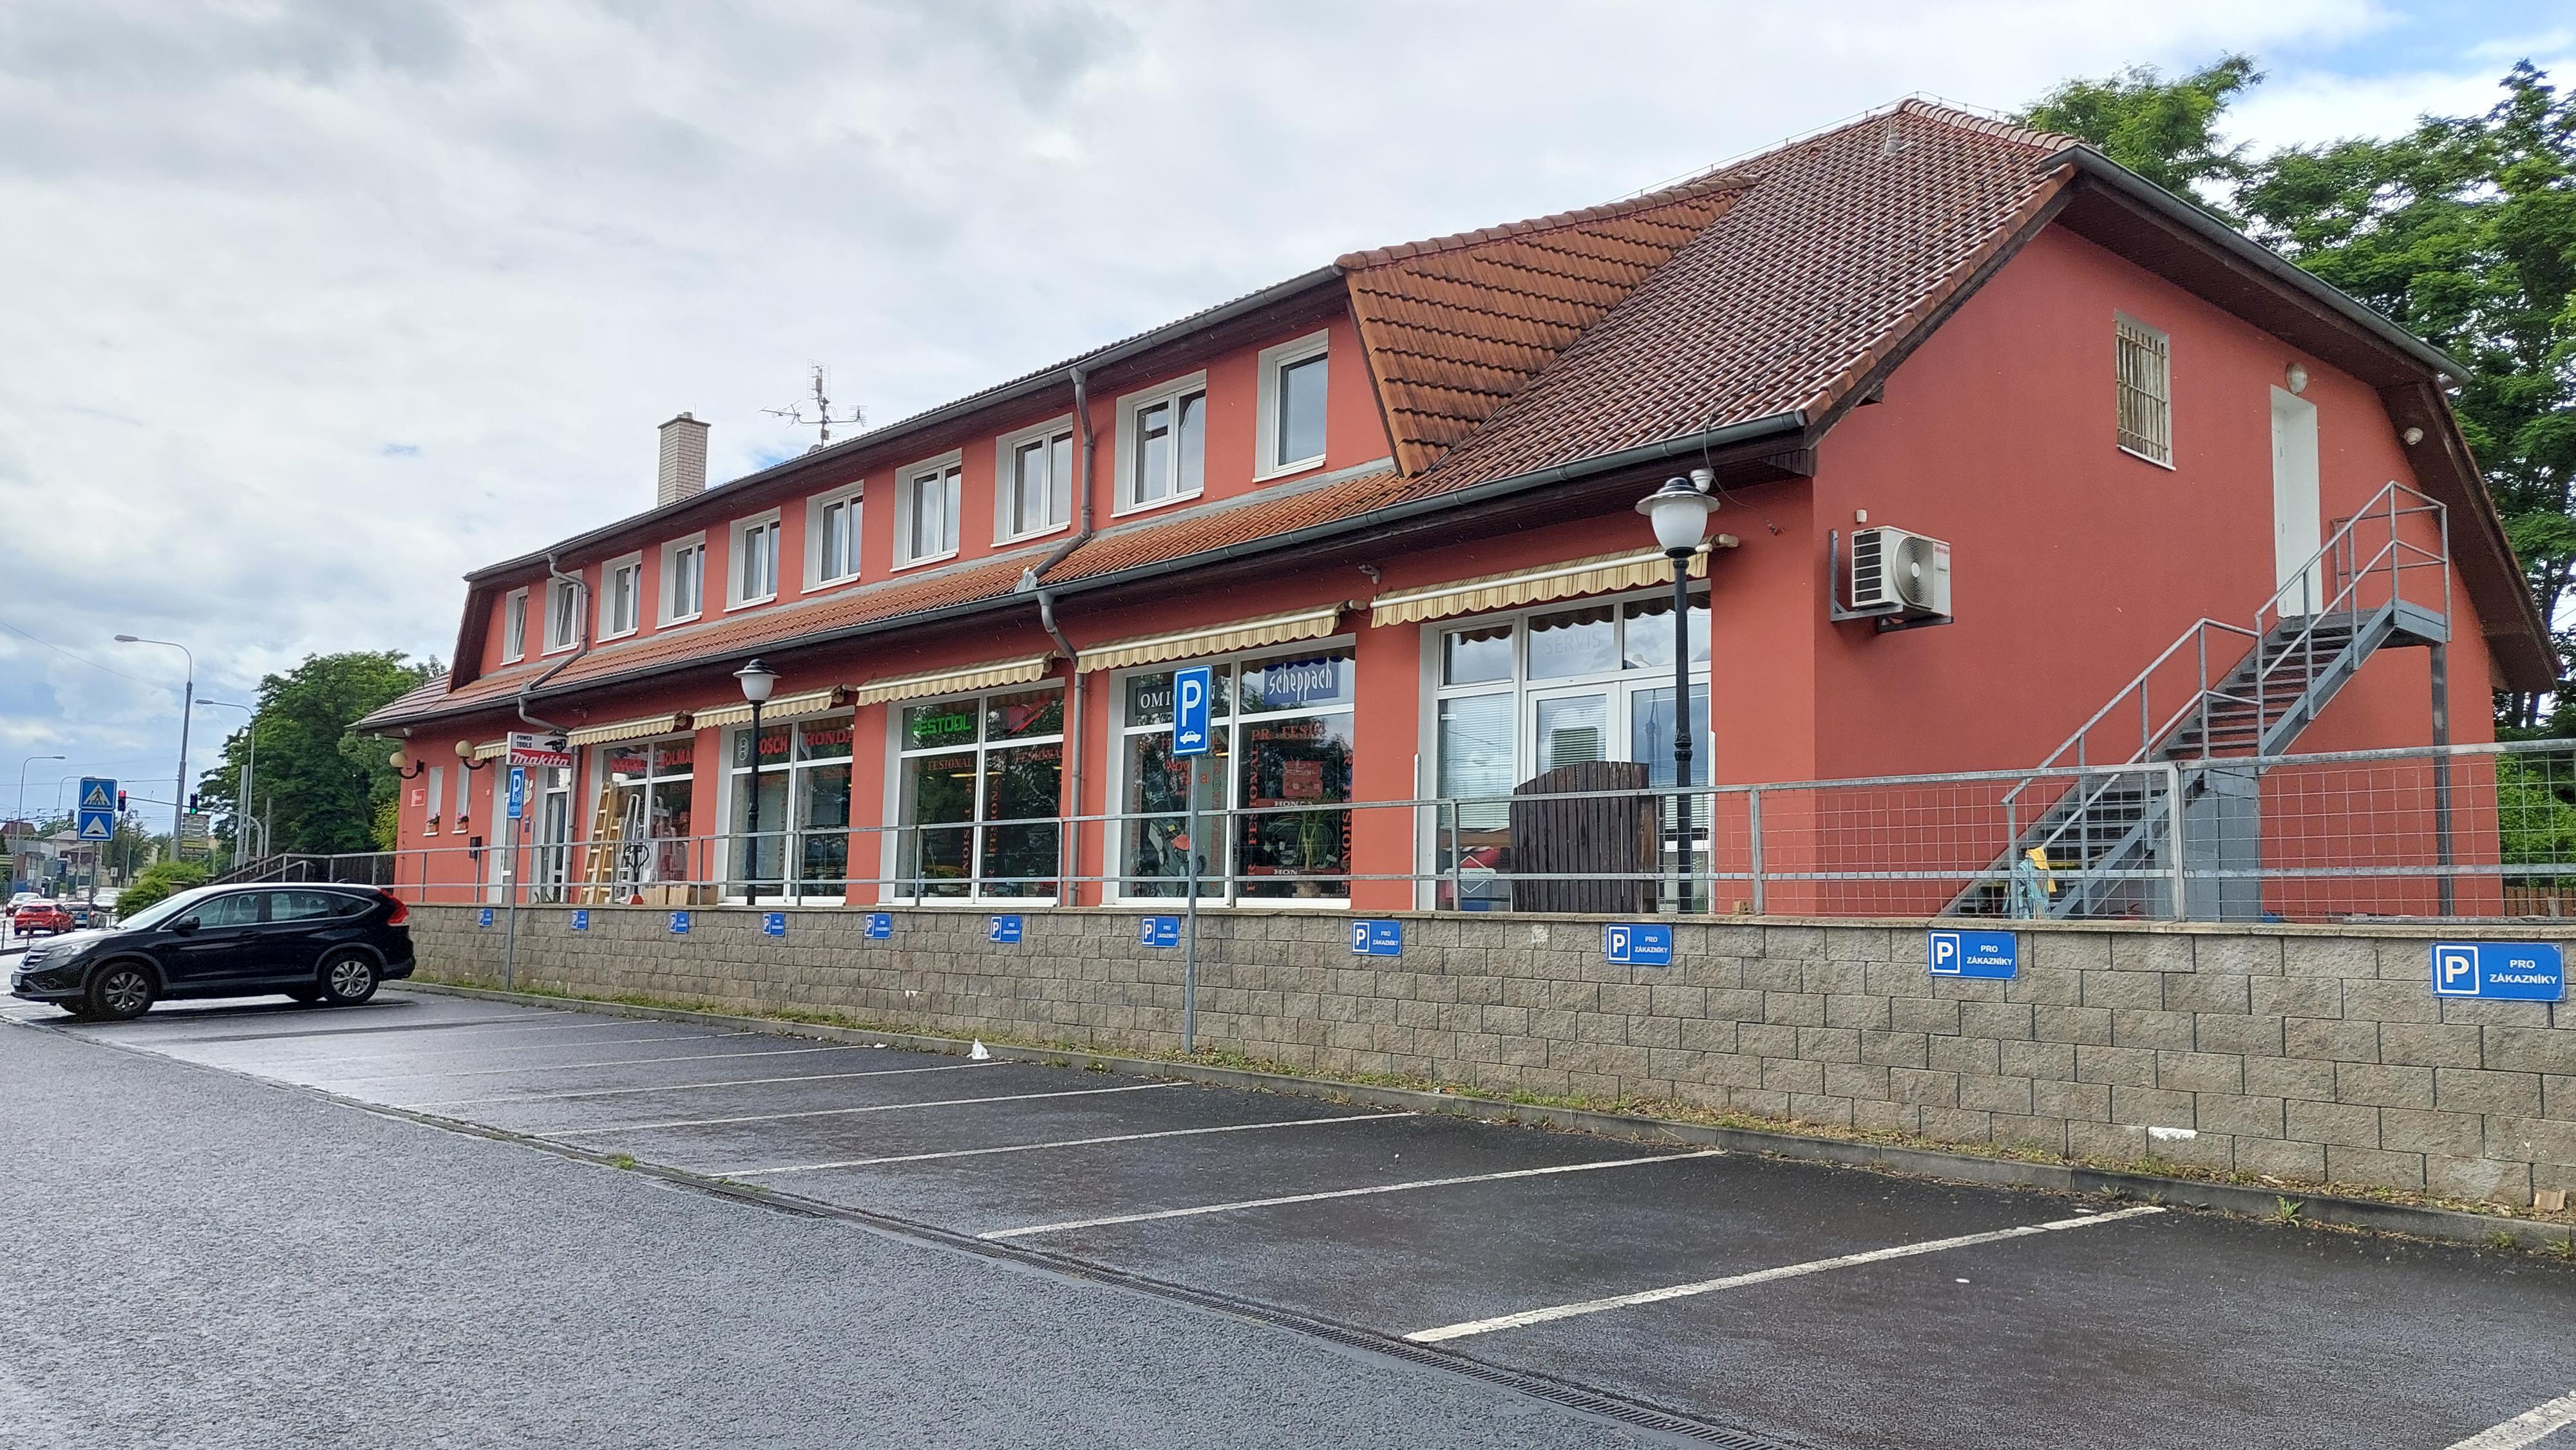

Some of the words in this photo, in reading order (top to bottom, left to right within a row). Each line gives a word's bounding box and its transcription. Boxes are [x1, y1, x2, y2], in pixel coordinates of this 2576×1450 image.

[1269, 657, 1332, 702] scheppach
[1182, 679, 1202, 727] P
[912, 714, 972, 736] FESTOOL
[759, 735, 788, 755] OSCH
[806, 731, 853, 748] HONDA
[512, 775, 521, 802] P
[867, 919, 873, 932] P
[992, 921, 999, 936] P
[1144, 924, 1152, 939] P
[1356, 928, 1366, 946] P
[1613, 934, 1625, 953] P
[1634, 945, 1668, 954] ZÁKAZNÍKY
[1937, 941, 1954, 965] P
[1980, 945, 1998, 953] PRO
[1966, 956, 2013, 966] ZÁKAZNÍKY
[2445, 956, 2470, 983] P
[2510, 959, 2536, 969] PRO
[2489, 972, 2558, 984] ZÁKAZNÍKY
